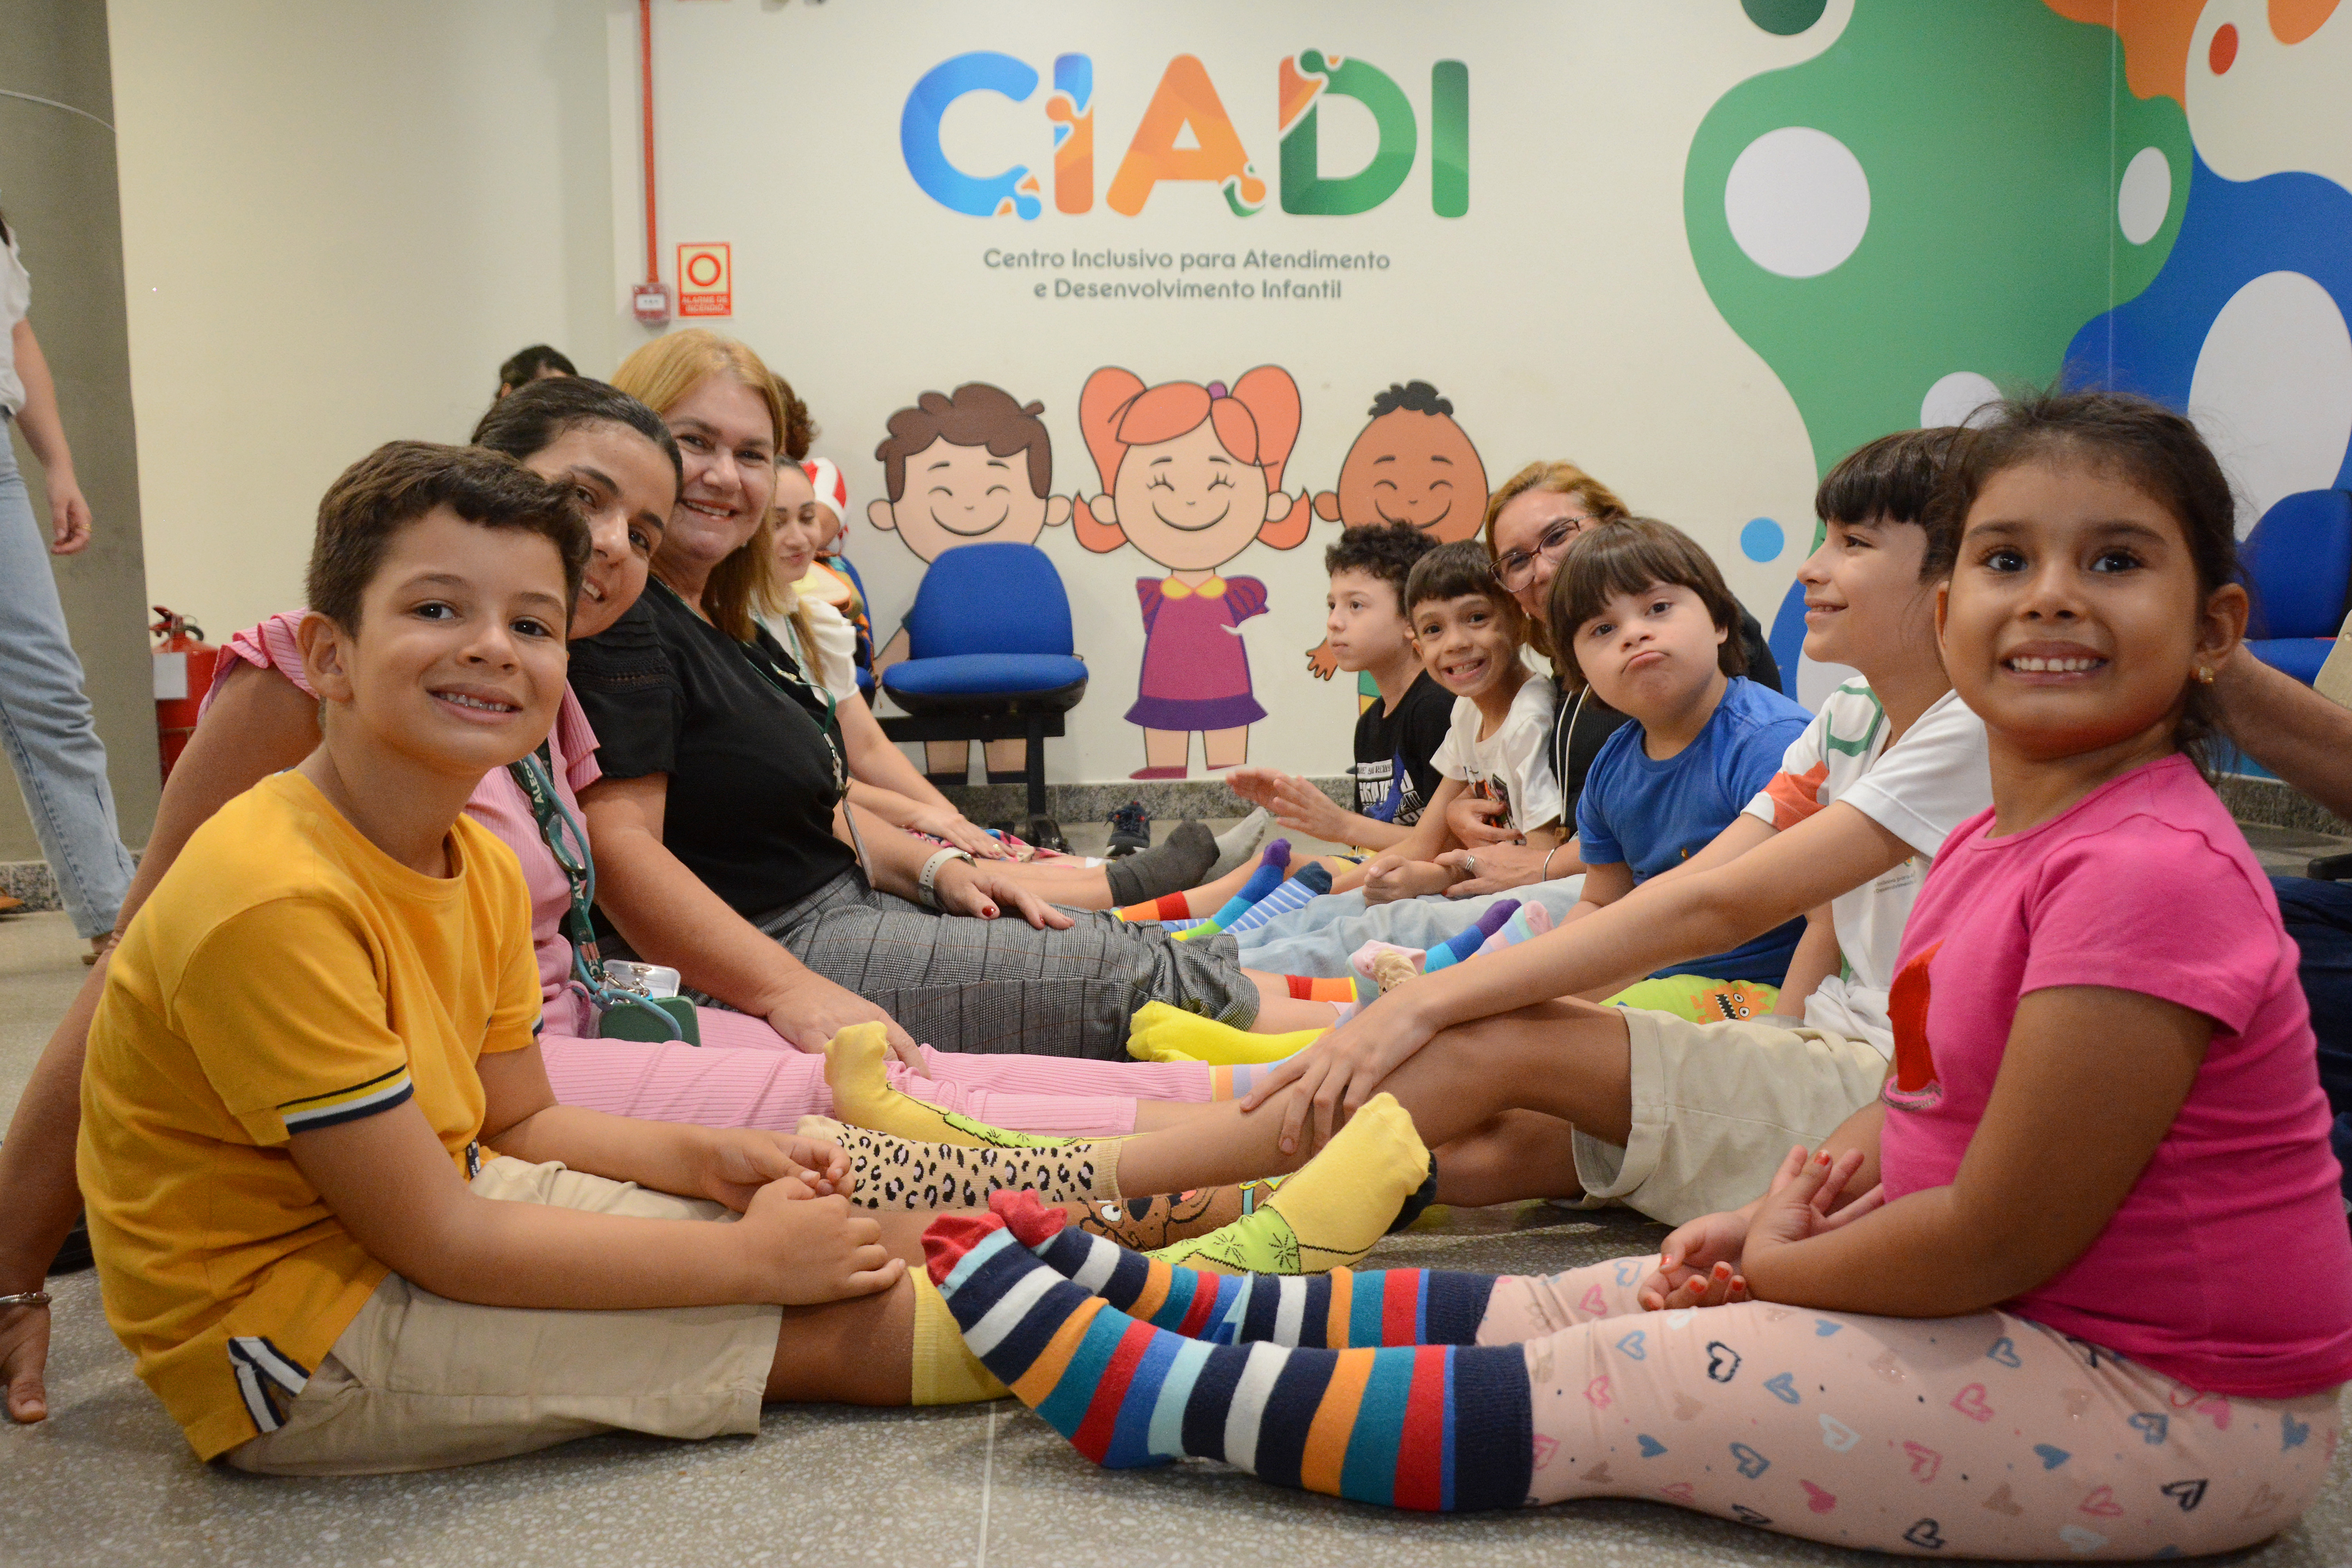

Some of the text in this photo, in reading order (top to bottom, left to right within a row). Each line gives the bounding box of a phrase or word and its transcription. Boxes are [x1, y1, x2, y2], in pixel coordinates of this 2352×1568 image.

[900, 48, 1470, 220] CIADI
[983, 248, 1390, 272] Centro Inclusivo para Atendimento
[1034, 278, 1341, 298] e Desenvolvimento Infantil
